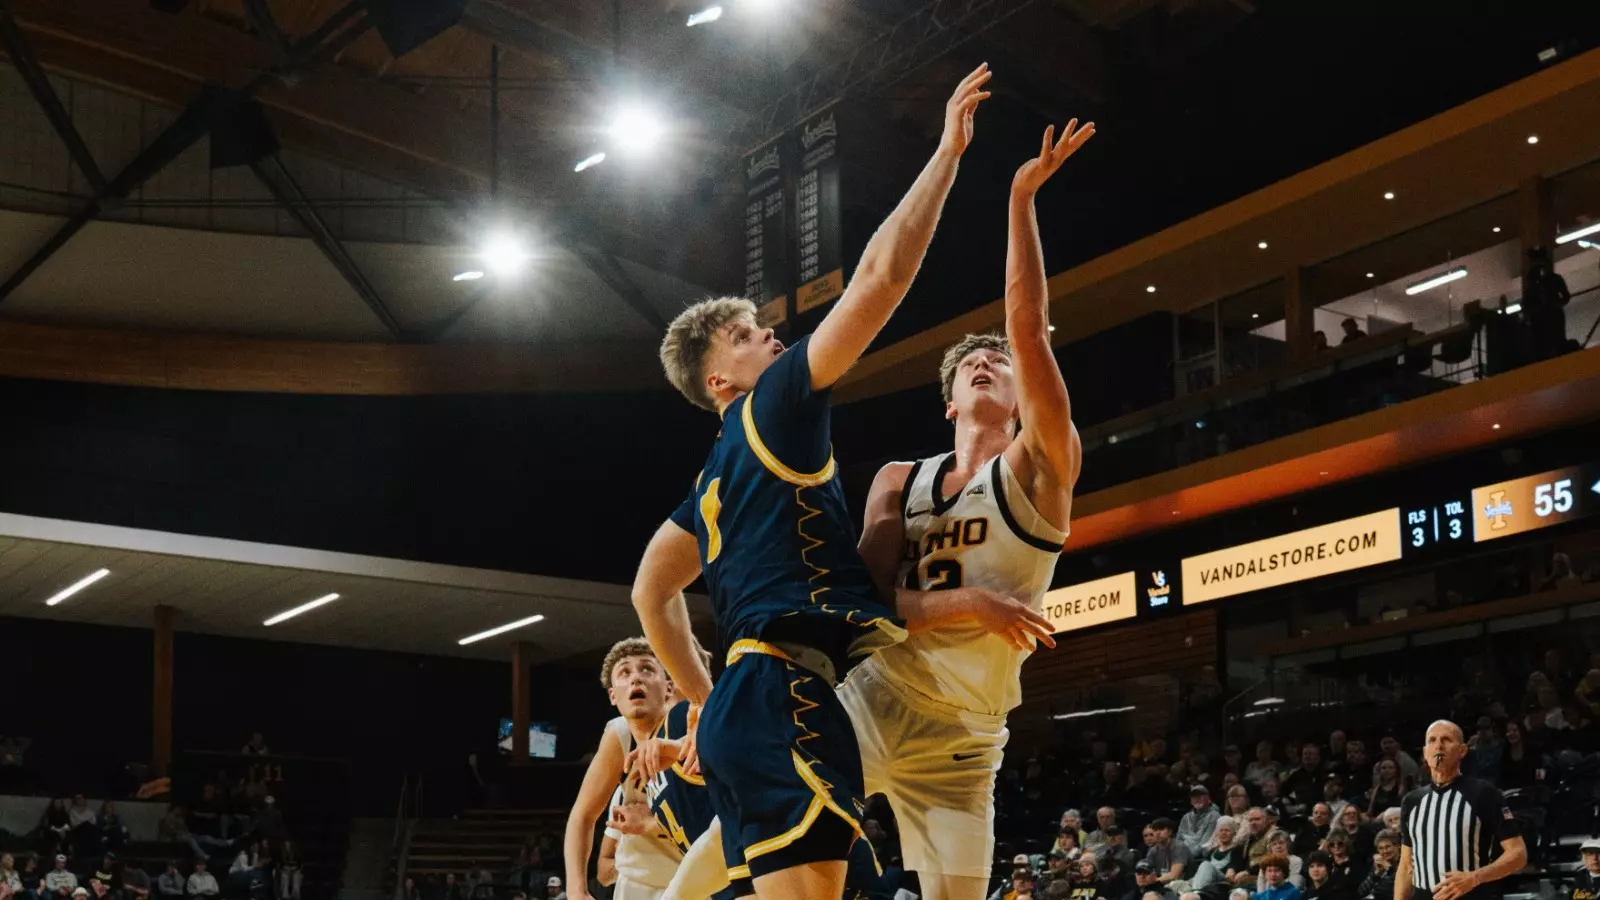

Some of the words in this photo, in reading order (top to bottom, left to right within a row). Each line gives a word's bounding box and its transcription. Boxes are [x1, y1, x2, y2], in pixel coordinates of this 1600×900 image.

[1408, 510, 1426, 525] FLS
[1445, 501, 1464, 516] TOL
[1534, 479, 1573, 517] 55
[1412, 527, 1424, 547] 3
[1449, 519, 1461, 539] 3
[1200, 531, 1377, 585] VANDALSTORE.COM
[1042, 590, 1120, 620] TORE.COM
